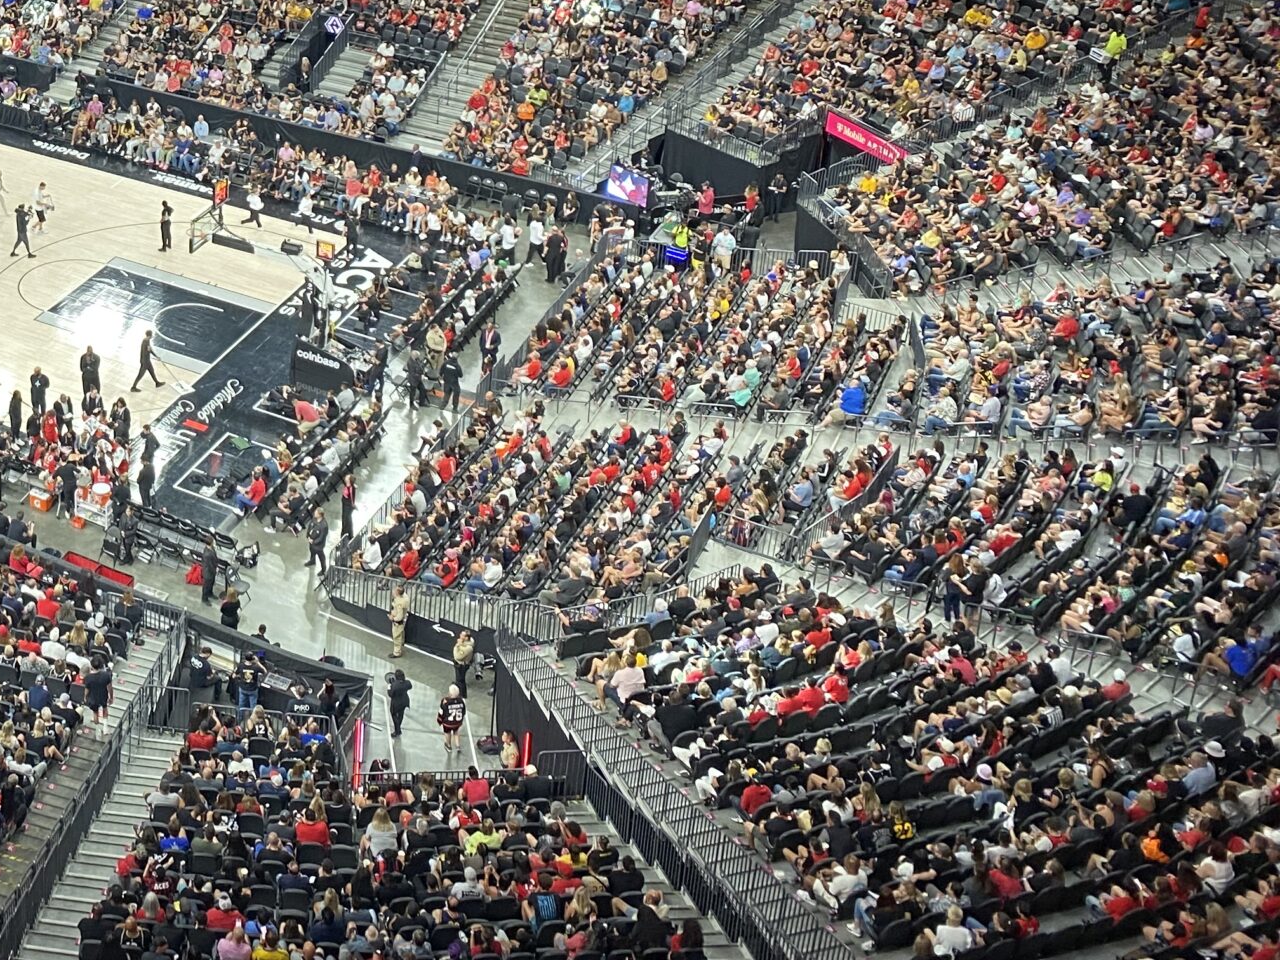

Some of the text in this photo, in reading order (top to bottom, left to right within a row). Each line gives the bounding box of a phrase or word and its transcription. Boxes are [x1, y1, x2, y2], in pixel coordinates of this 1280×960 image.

[843, 126, 866, 143] Mobile
[296, 348, 341, 369] coinbase
[197, 378, 244, 424] Michelob
[294, 704, 310, 712] PYRO
[254, 725, 265, 734] 12
[153, 881, 169, 891] ACES
